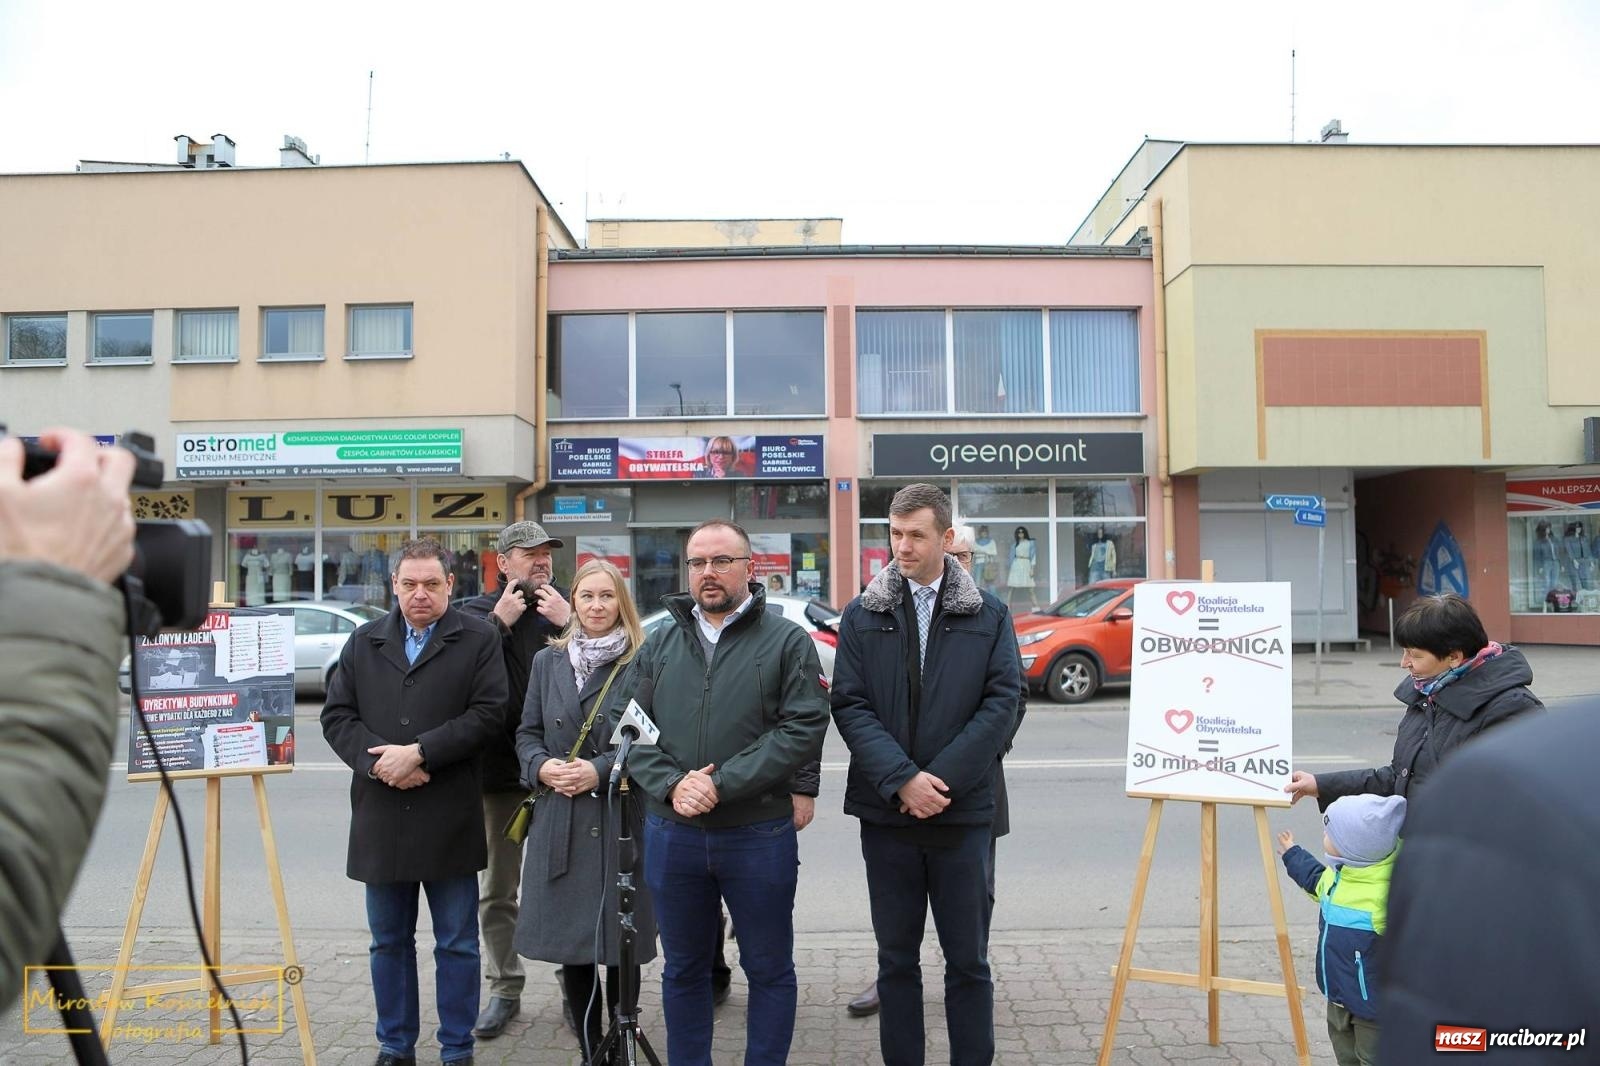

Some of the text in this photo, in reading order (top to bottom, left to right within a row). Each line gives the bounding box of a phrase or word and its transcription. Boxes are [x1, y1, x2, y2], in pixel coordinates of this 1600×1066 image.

[183, 433, 276, 453] ostromed
[286, 434, 339, 443] KOMPLEKSOWA
[340, 434, 388, 442] DIAGNOSTYKA
[404, 433, 428, 441] COLOR
[428, 432, 459, 441] DOPPLER
[183, 452, 277, 463] CENTRUM MEDYCZNE
[343, 448, 457, 457] ZESPÓŁ GABINETÓW LEKARSKICH
[646, 449, 684, 459] STREFA
[929, 438, 1088, 471] greenpoint
[629, 462, 705, 474] OBYWATELSKA
[1542, 484, 1600, 495] NAJLEPSZA
[1198, 596, 1238, 606] Koalicja
[1198, 604, 1265, 614] Obywatelska
[214, 614, 227, 630] ZA
[1140, 637, 1284, 655] OBWODNICA
[1202, 676, 1214, 694] ?
[159, 711, 183, 721] WYDATKI
[222, 707, 233, 717] NAS
[1196, 716, 1236, 726] Koalicja
[1196, 724, 1262, 735] Obywatelska
[1132, 753, 1290, 775] 30 min dla ANS
